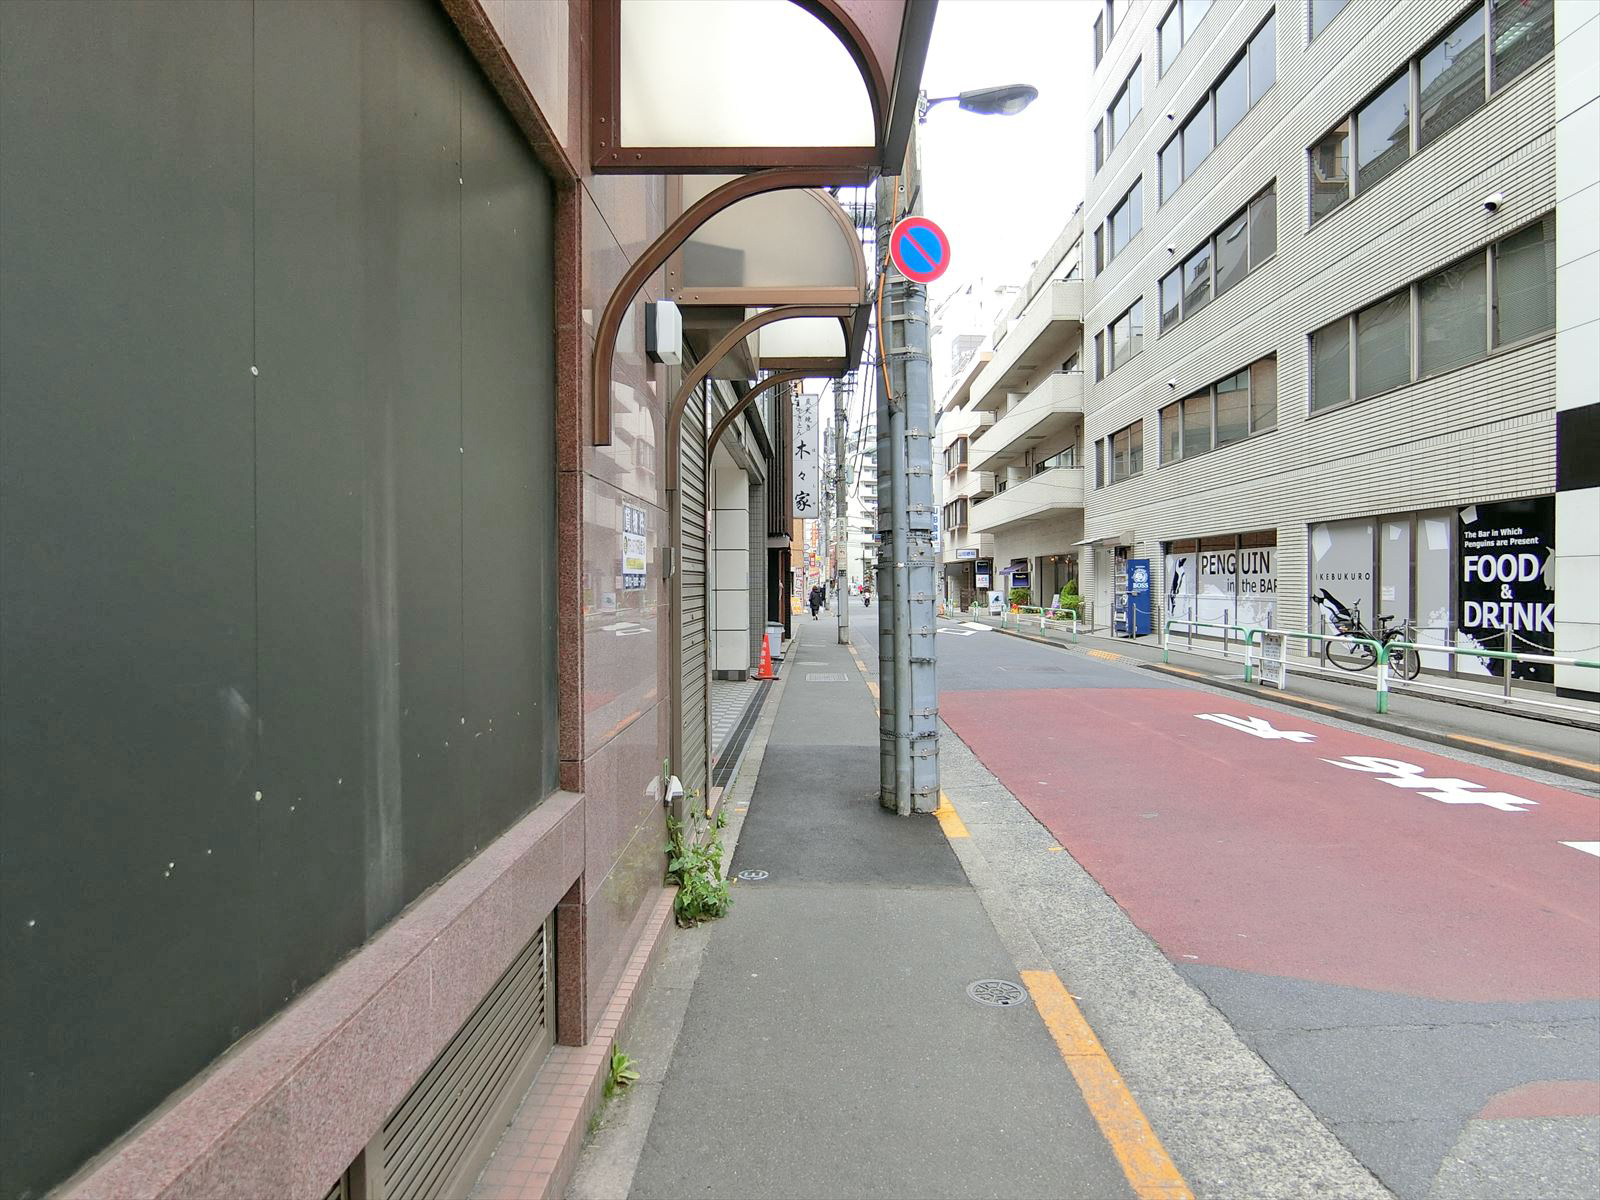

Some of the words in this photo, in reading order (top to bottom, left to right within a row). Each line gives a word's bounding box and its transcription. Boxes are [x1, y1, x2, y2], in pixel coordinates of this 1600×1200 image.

[795, 440, 811, 511] 木々家
[1464, 540, 1495, 548] Penguins
[1510, 537, 1539, 545] Present
[1478, 530, 1490, 538] Bar
[1500, 528, 1523, 536] Which
[1201, 551, 1270, 575] PENGUIN
[1464, 553, 1539, 582] FOOD
[1227, 578, 1234, 592] in
[1242, 579, 1256, 593] the
[1500, 584, 1513, 599] &
[1464, 601, 1555, 633] DRINK
